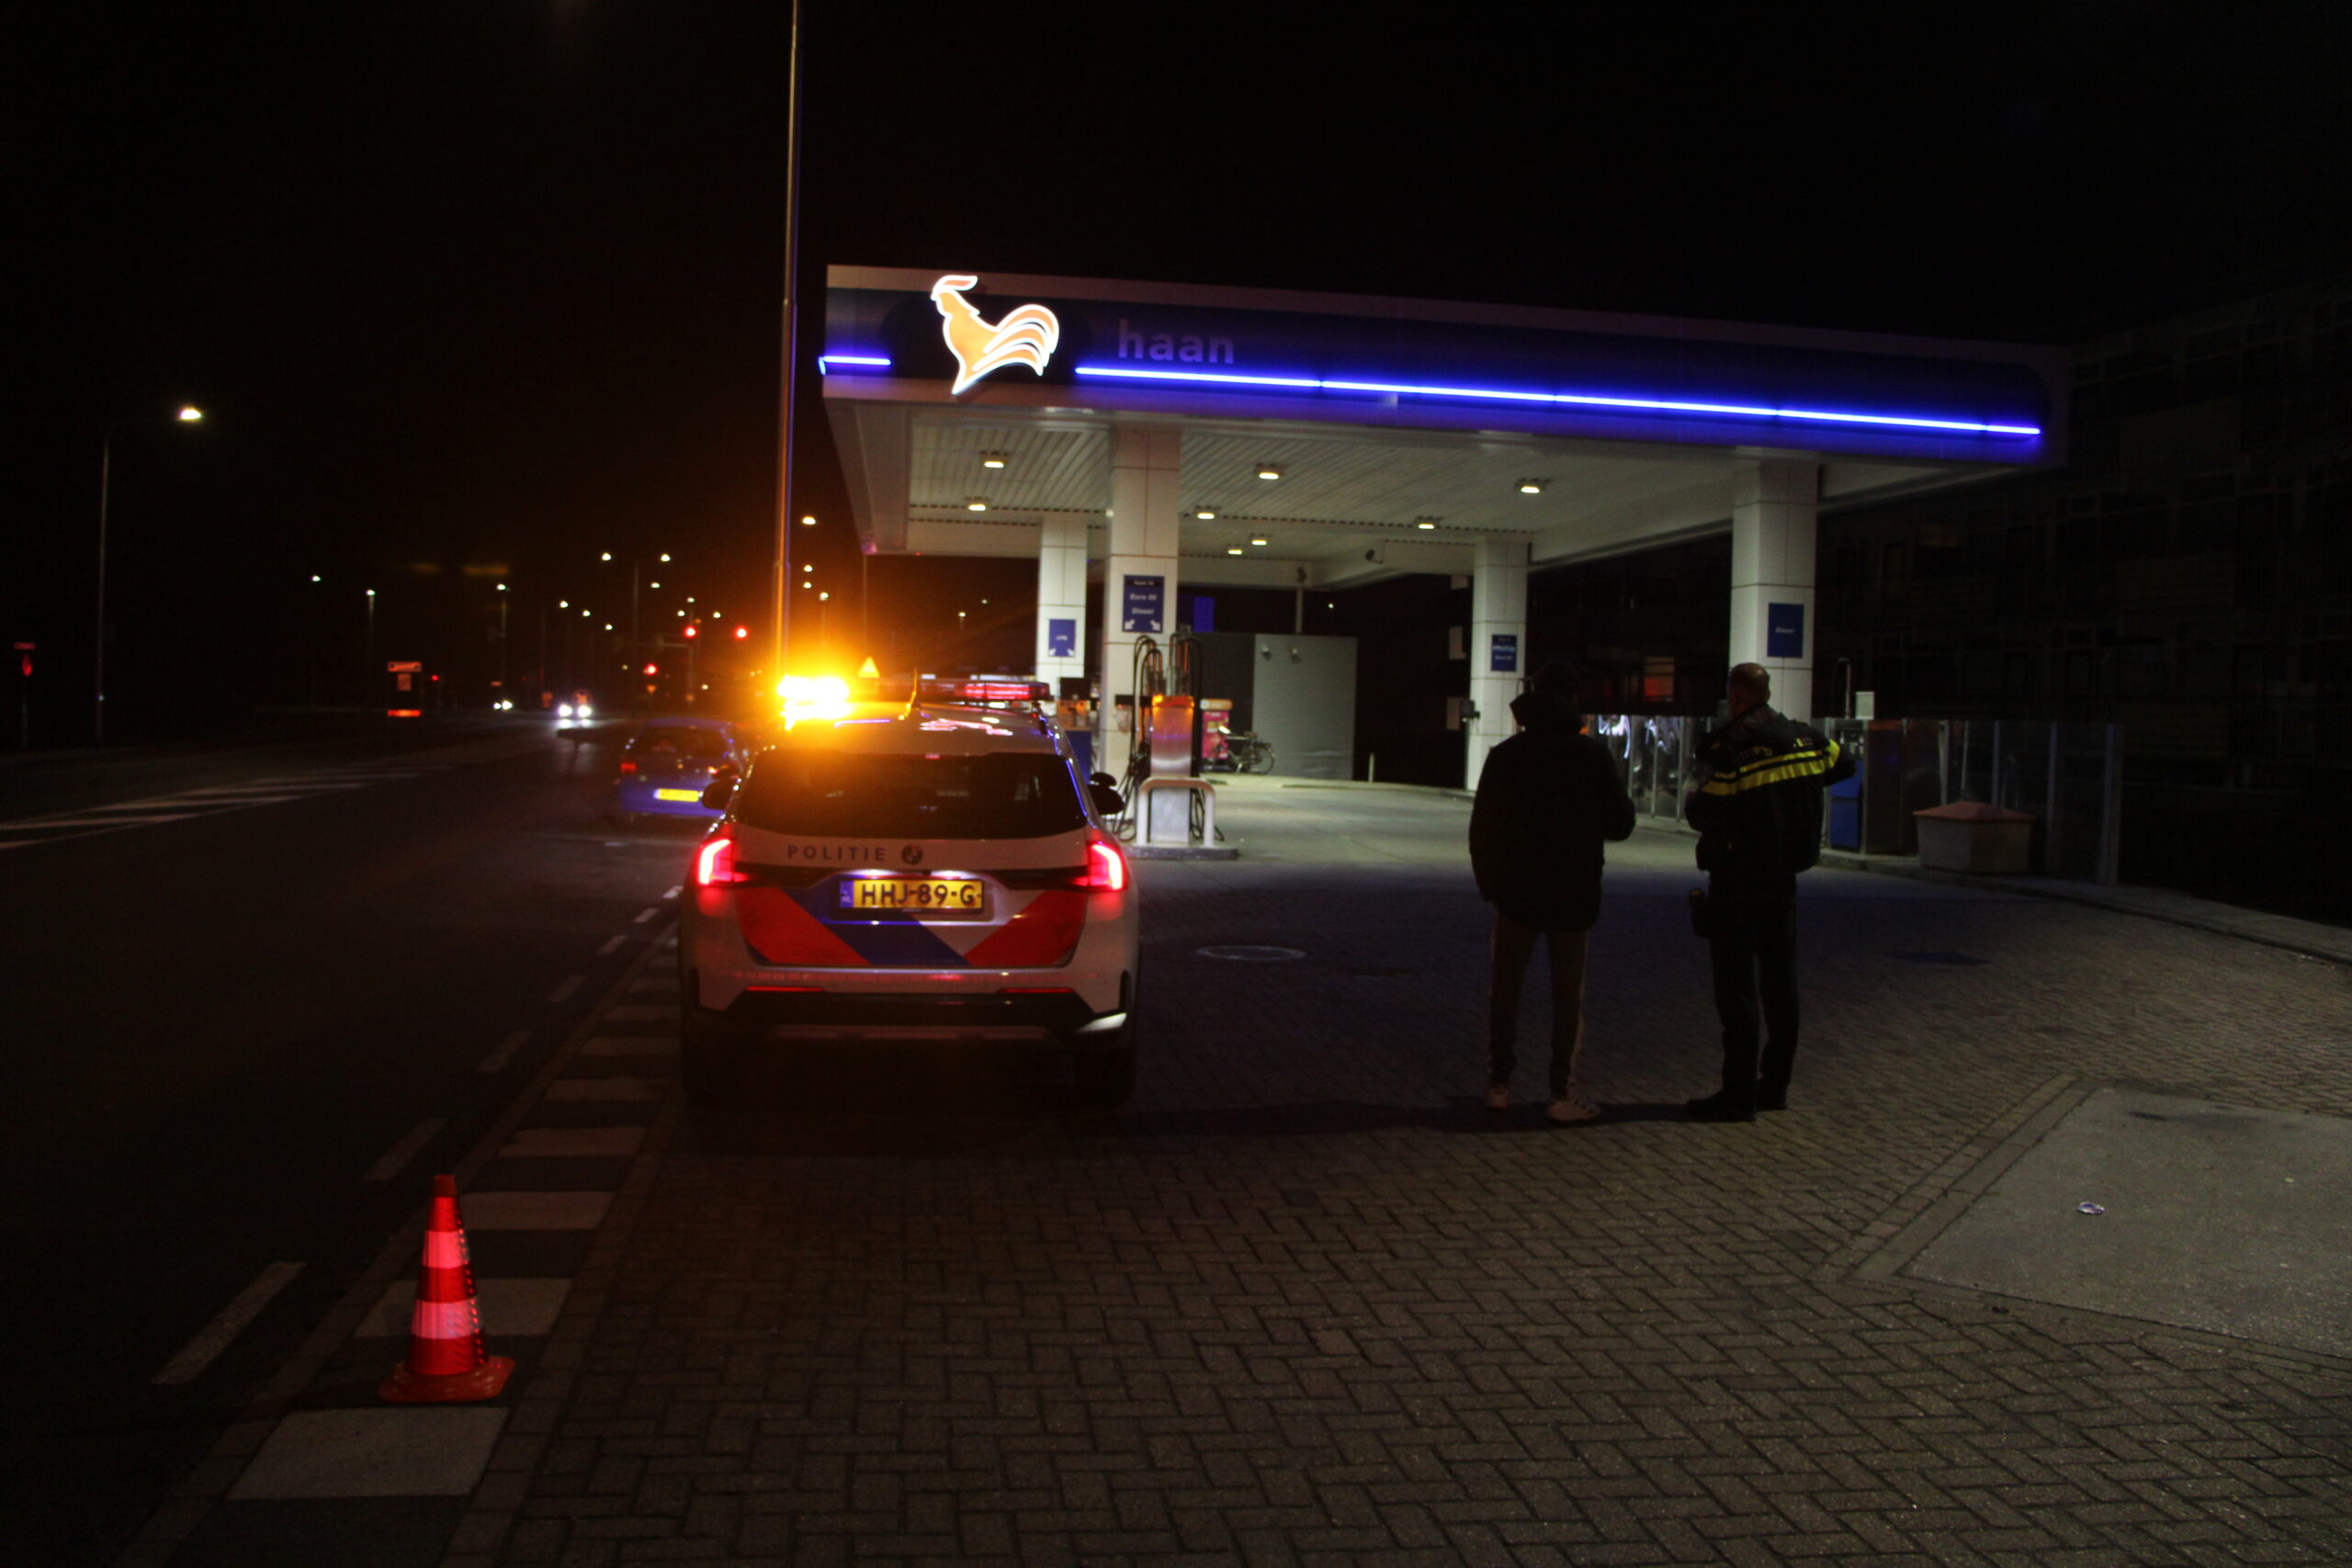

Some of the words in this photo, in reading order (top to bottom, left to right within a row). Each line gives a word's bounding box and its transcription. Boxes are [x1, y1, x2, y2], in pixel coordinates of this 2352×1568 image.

[1118, 318, 1235, 364] haan
[787, 844, 886, 862] POLITIE
[861, 883, 977, 907] HHJ-89-G
